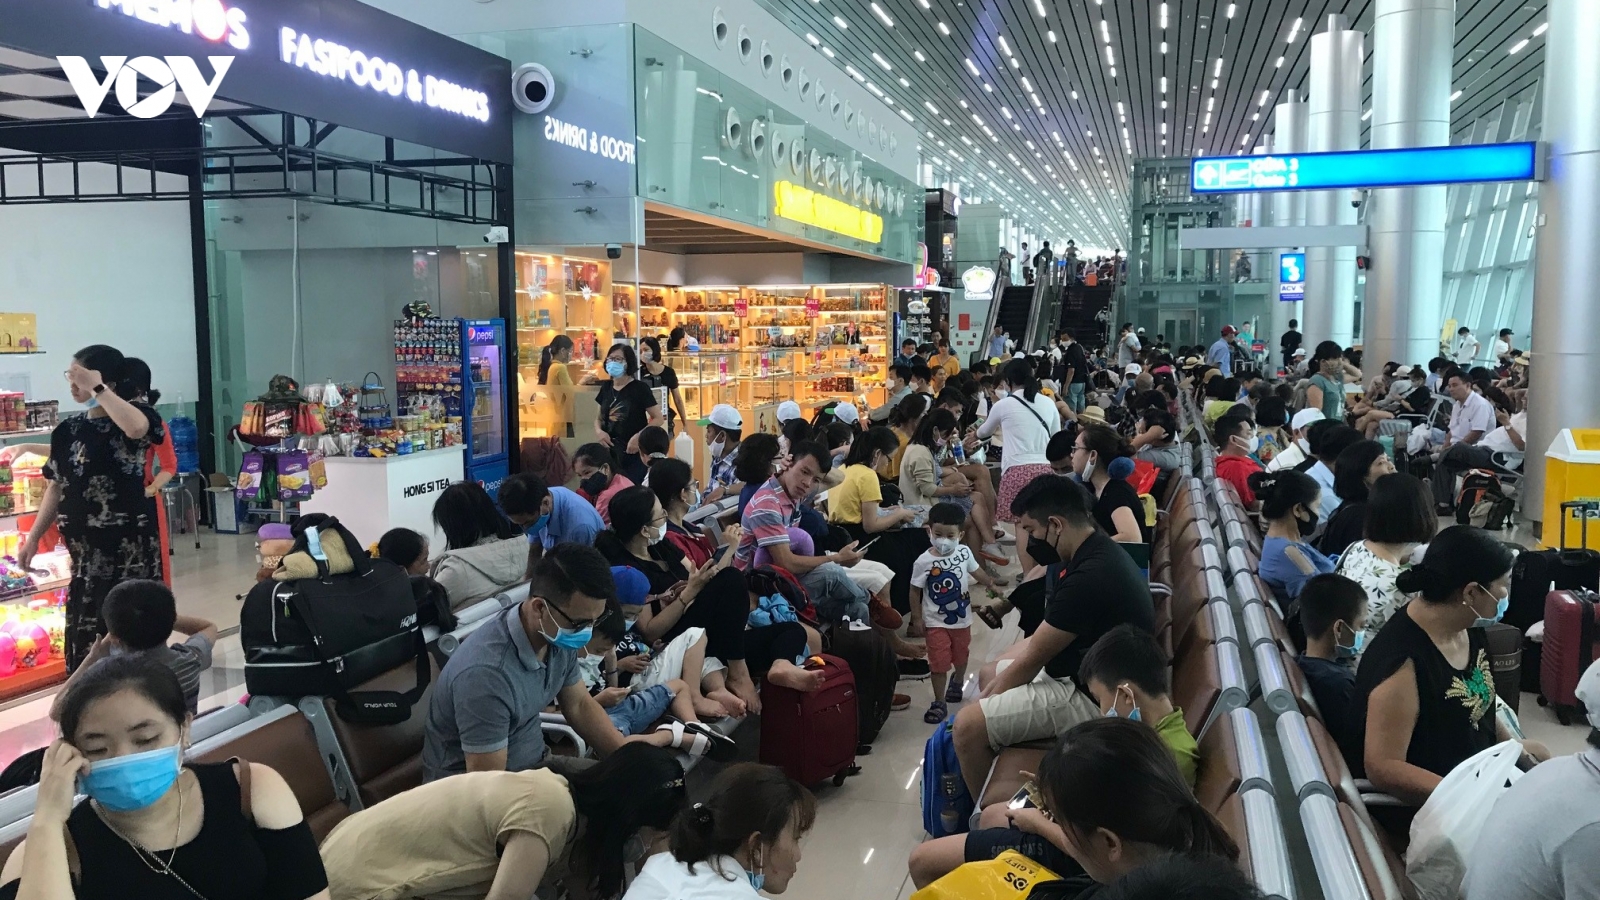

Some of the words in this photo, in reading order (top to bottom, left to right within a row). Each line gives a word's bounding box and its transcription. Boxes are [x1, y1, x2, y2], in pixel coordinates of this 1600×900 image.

[279, 26, 403, 97] FASTFOOD
[405, 68, 423, 103] &
[476, 330, 494, 342] pepsi
[403, 482, 427, 499] HONG
[427, 480, 435, 493] SI
[435, 477, 450, 491] TEA
[1005, 859, 1027, 872] GIFT
